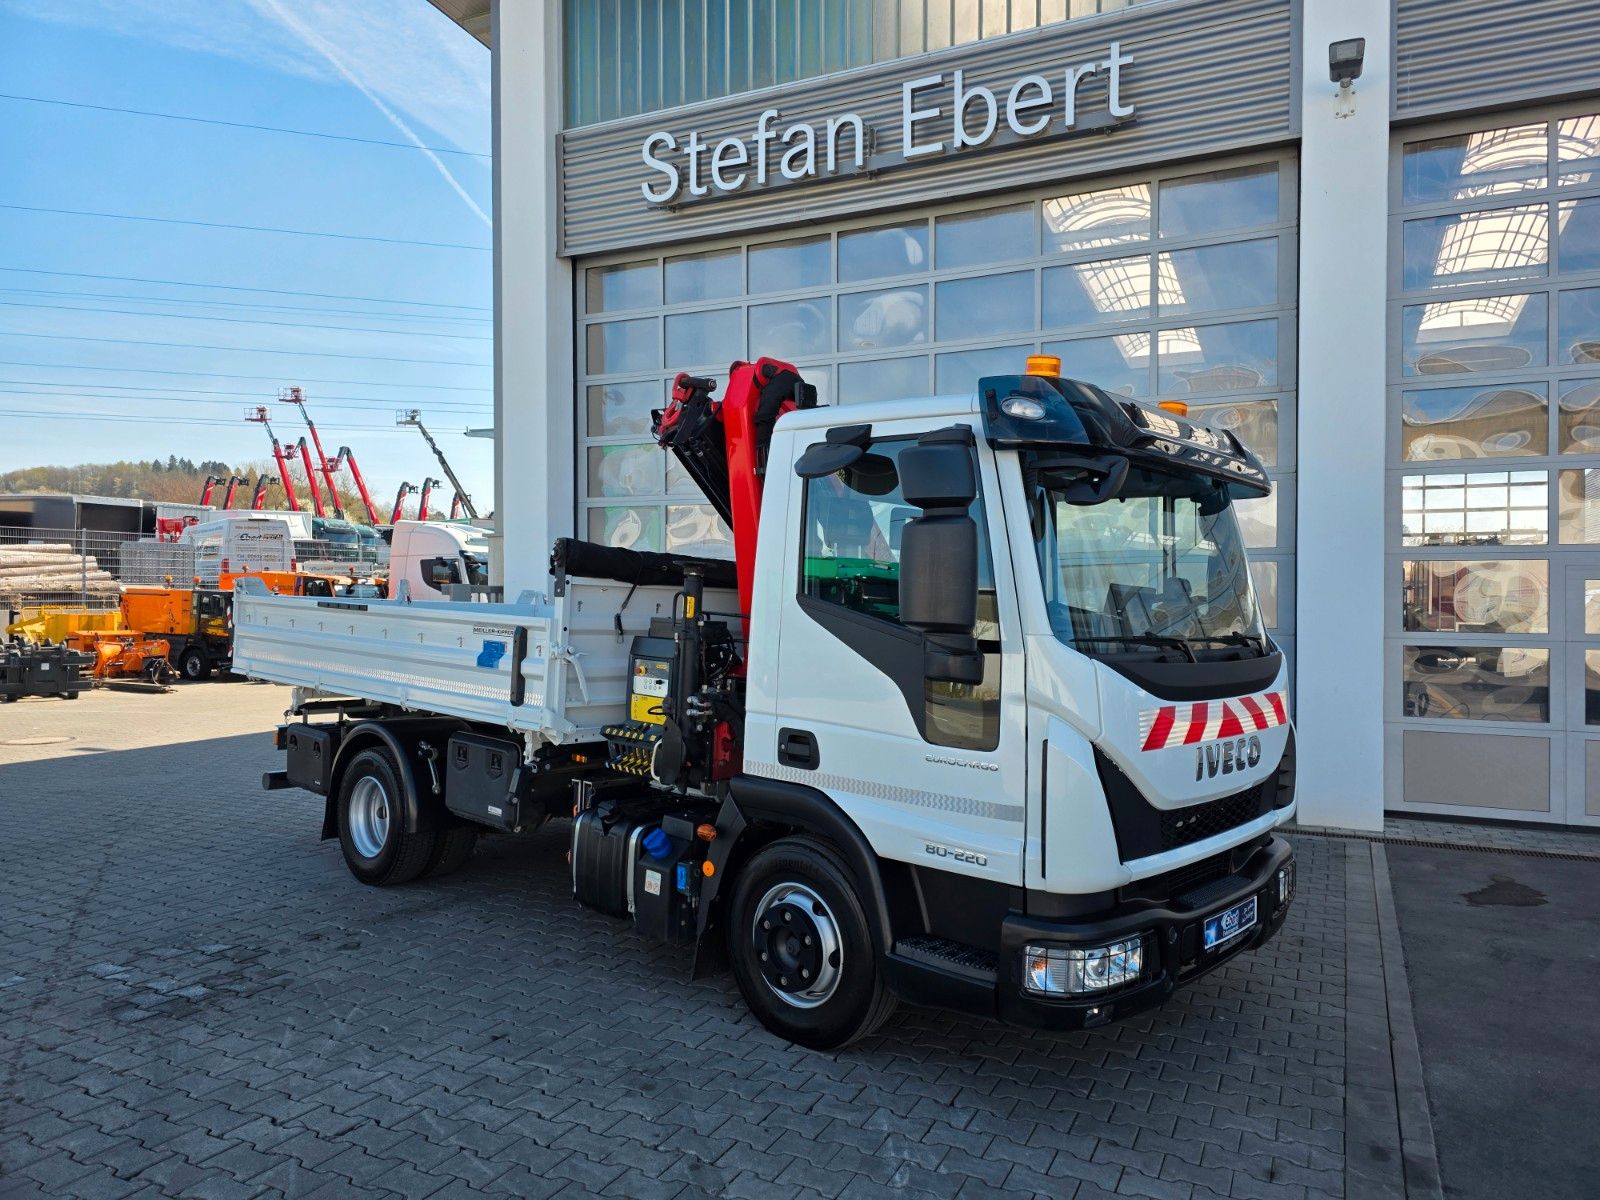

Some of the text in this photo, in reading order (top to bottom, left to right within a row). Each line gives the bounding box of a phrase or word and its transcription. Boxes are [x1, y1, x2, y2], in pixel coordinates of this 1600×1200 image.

[641, 41, 1136, 203] Stefan Ebert
[925, 754, 999, 772] EUROCARGO
[1195, 735, 1261, 782] IVECO
[925, 843, 988, 867] 80-220
